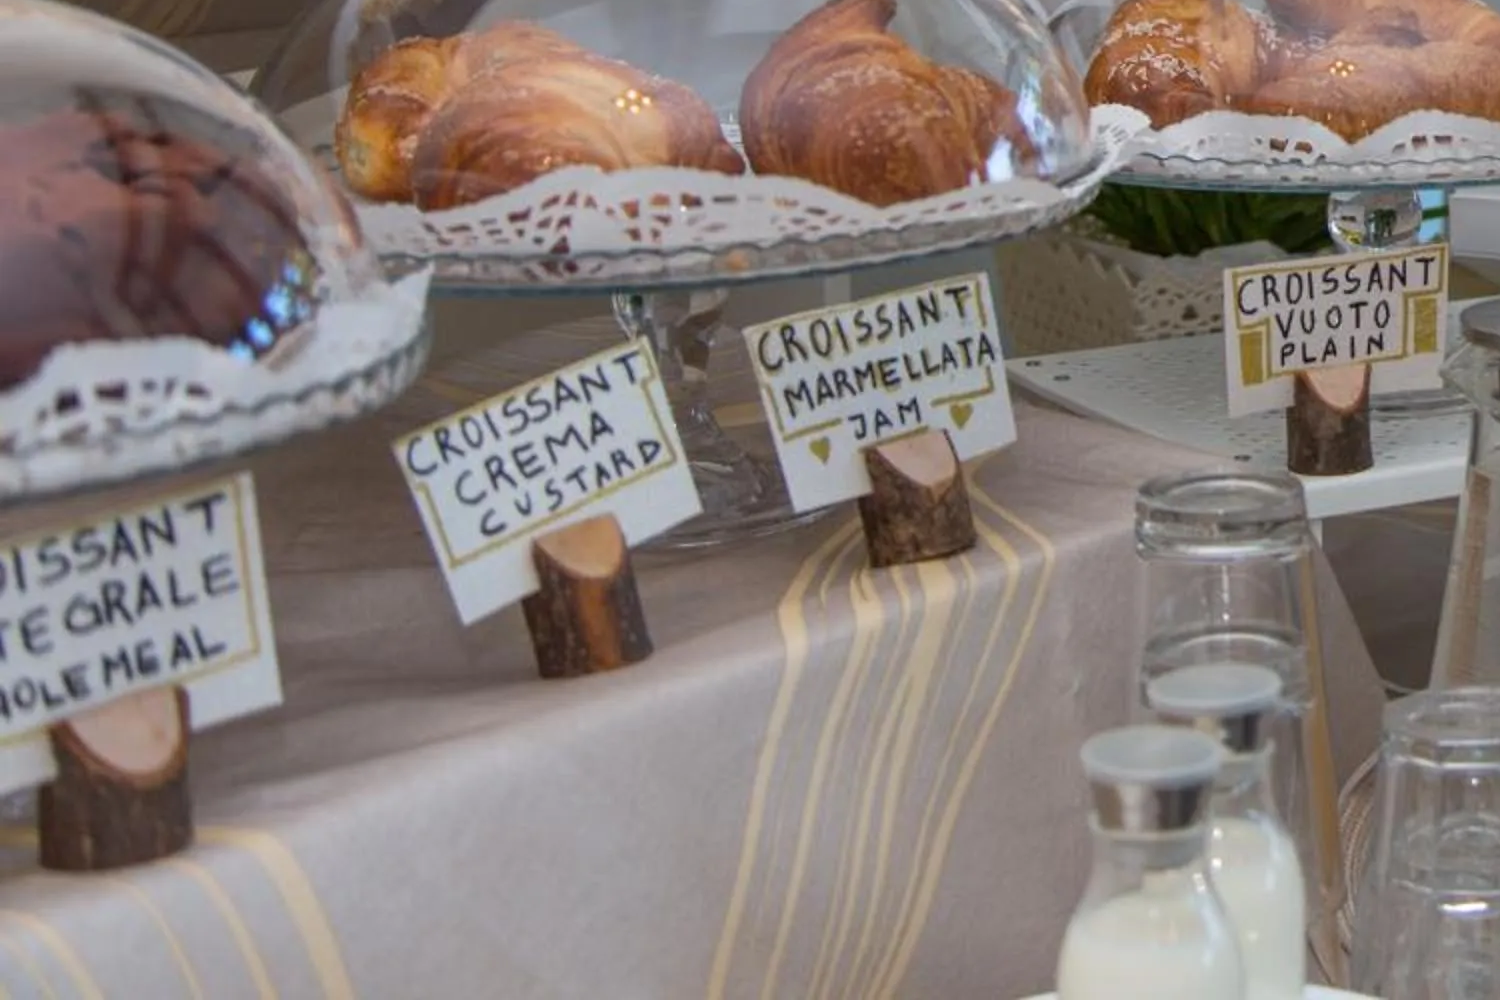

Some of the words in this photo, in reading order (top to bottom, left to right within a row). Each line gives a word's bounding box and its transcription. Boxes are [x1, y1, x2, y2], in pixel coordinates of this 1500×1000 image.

[757, 286, 969, 373] CROISSANT
[1237, 257, 1436, 316] CROISSANT
[1275, 300, 1392, 340] VUOTO
[782, 332, 996, 419] MARMELLATA
[1280, 332, 1385, 367] PLAIN
[406, 350, 641, 477] CROISSANT
[848, 397, 922, 440] JAM
[454, 410, 614, 505] CREMA
[479, 439, 662, 537] CUSTARD
[0, 491, 228, 597] ISSANT
